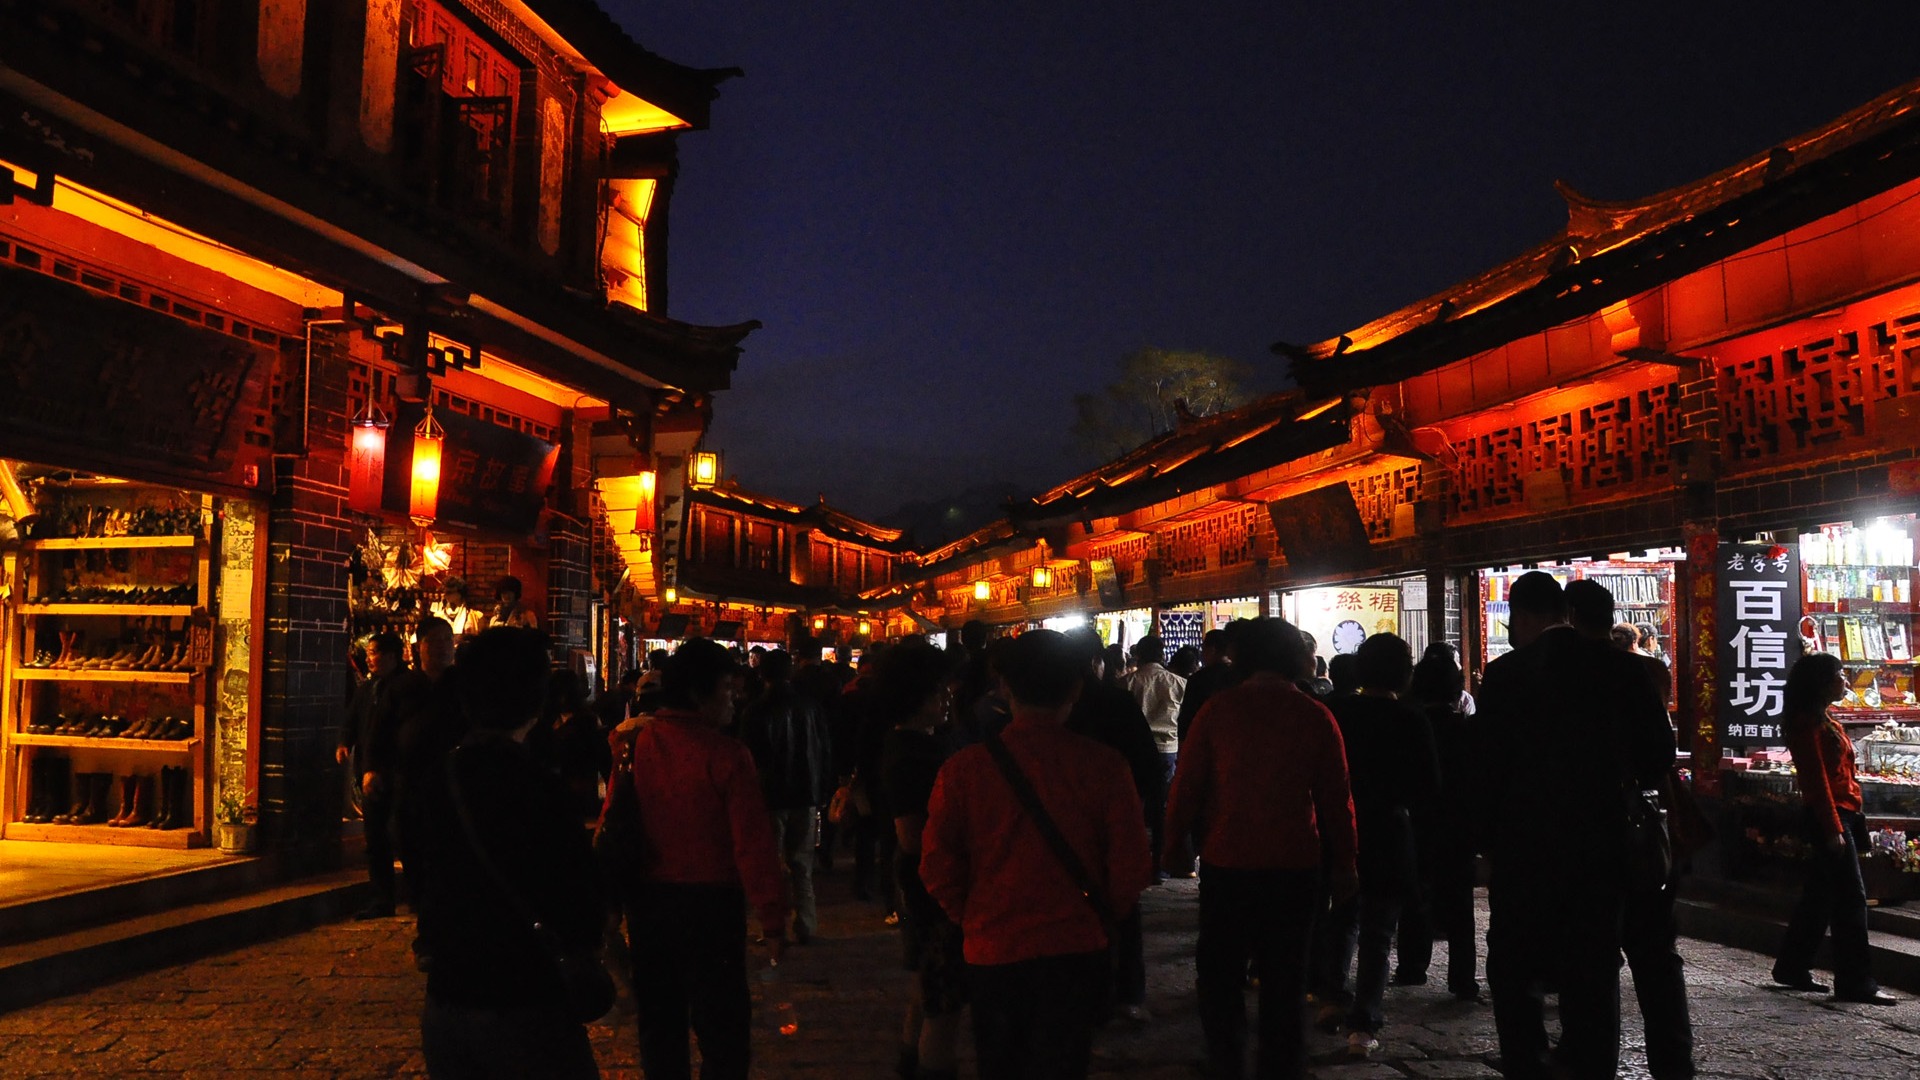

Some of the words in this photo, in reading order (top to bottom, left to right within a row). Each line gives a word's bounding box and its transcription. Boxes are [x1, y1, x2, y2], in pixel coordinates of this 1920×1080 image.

[1727, 551, 1791, 574] 老字号
[1729, 580, 1789, 717] 百信坊
